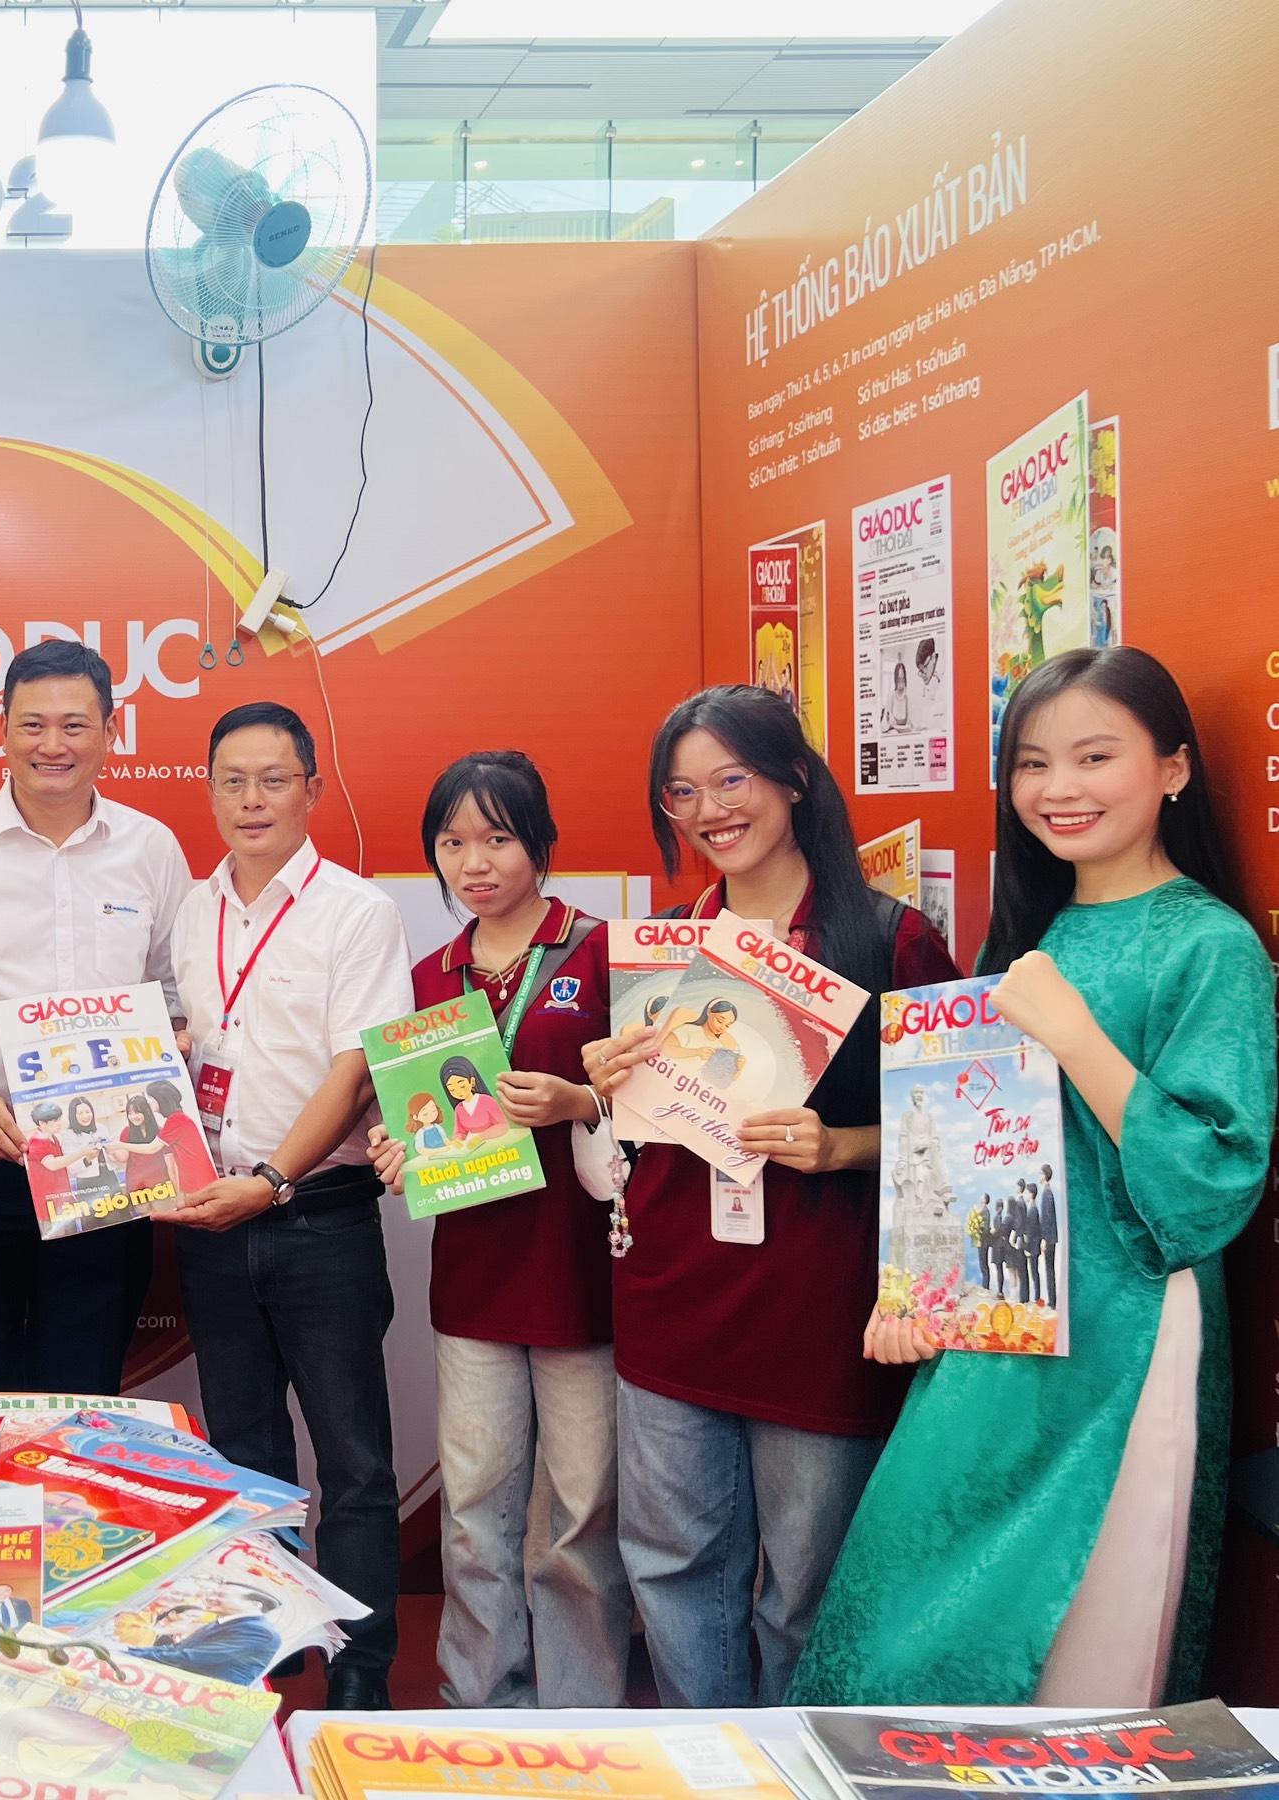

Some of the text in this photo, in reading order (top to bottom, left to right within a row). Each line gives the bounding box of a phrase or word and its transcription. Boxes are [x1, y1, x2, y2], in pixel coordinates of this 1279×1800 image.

[745, 131, 1027, 368] HỆ THỐNG BÁO XUẤT BẢN
[979, 274, 997, 301] Đà
[1039, 242, 1057, 268] TP
[1059, 220, 1102, 260] HCM.
[111, 764, 208, 782] VÀ ĐÀO TẠO
[635, 922, 696, 946] GIÁO
[736, 930, 793, 974] GIÁO
[789, 960, 841, 1003] DỤC
[18, 994, 133, 1024] GIÁO DỤC
[55, 1014, 91, 1032] THỜI
[902, 993, 977, 1034] GIÁO
[645, 1052, 727, 1114] Gói ghém
[652, 1098, 702, 1125] yêu
[417, 1145, 519, 1187] Khởi nguồn
[417, 1164, 533, 1207] cho thành công
[92, 1180, 177, 1218] gió mới
[171, 1434, 213, 1456] Nam
[343, 1730, 641, 1774] GIÁO DỤC
[879, 1727, 1197, 1768] GIÁO DỤC
